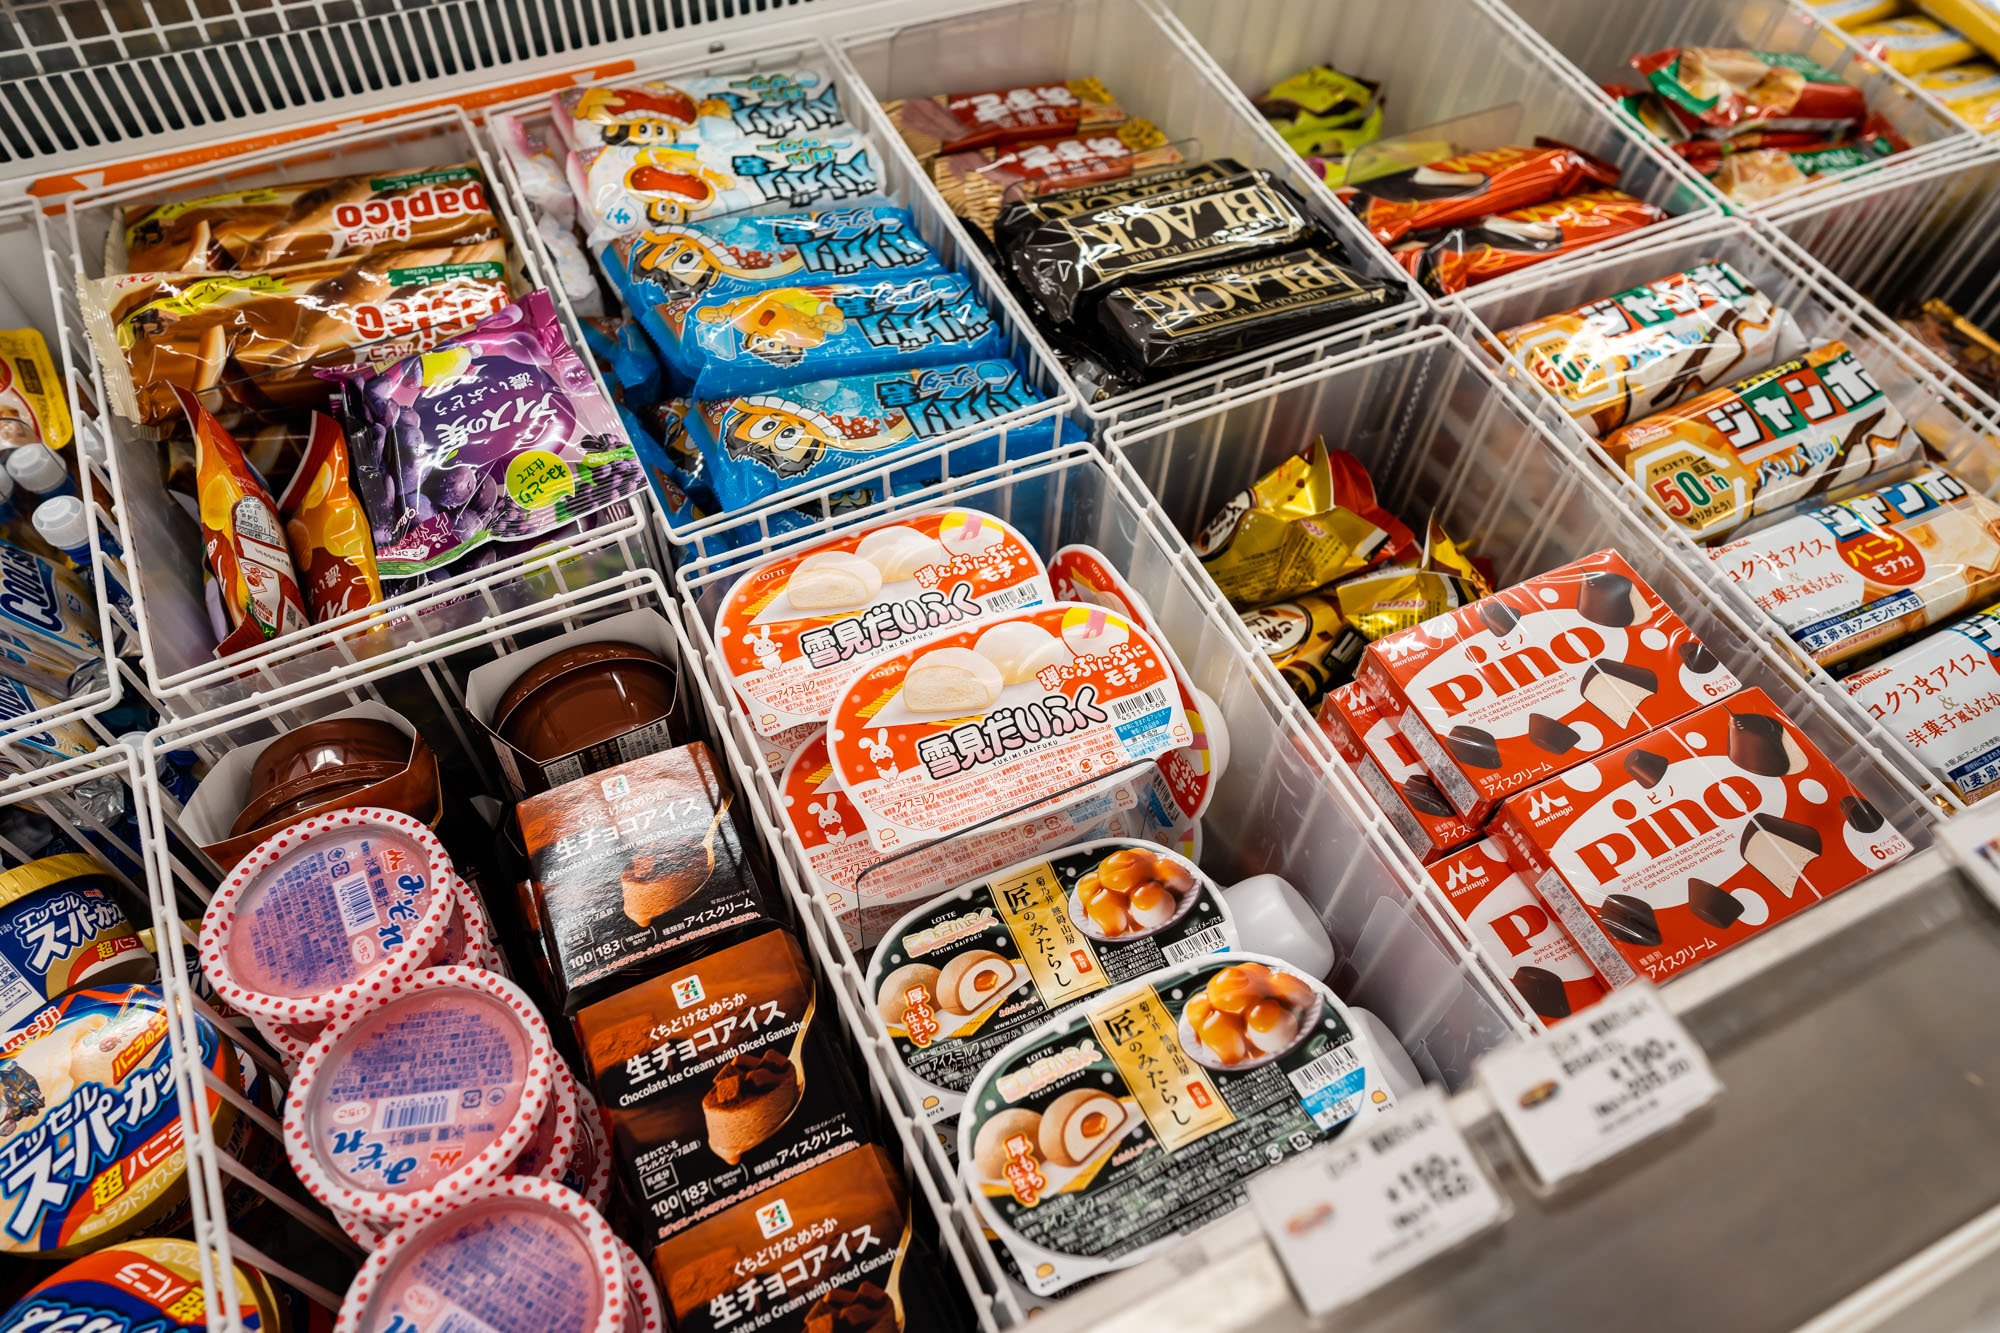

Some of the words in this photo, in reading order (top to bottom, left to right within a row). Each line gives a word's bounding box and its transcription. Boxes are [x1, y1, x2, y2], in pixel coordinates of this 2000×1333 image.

[336, 183, 491, 238] papico
[1081, 187, 1272, 259] BLACK
[1144, 261, 1340, 321] BLACK
[435, 371, 535, 418] 濃いぶどう
[1705, 355, 1884, 450] ジャンボ
[516, 457, 545, 484] 仕立て
[517, 463, 567, 505] ねっとり
[1653, 471, 1730, 518] 50th
[755, 567, 789, 583] LOTTE
[914, 543, 1021, 589] 弾むぷにぷに
[981, 560, 1016, 583] モチ
[1872, 555, 1916, 577] モナカ
[800, 583, 982, 670] 雪見だいふく
[869, 642, 901, 658] YUKIMI
[900, 630, 934, 646] DAIFUKU
[1497, 633, 1525, 653] ピノ
[1036, 643, 1148, 691] 弾むぷにぷに
[1104, 662, 1142, 688] モチ
[1391, 649, 1430, 669] morinaga
[1427, 625, 1605, 718] pino
[776, 679, 816, 700] アイスミルク
[1703, 679, 1738, 698] 6粒入り
[1867, 653, 1986, 721] コクうまアイス
[1938, 694, 1960, 711] &
[1144, 699, 1166, 713] 6568
[1468, 704, 1486, 718] SINCE
[1486, 704, 1507, 719] CREAM
[1506, 694, 1533, 712] COVERED
[1488, 713, 1500, 725] FOR
[1500, 708, 1512, 721] YOU
[1521, 697, 1540, 712] ENJOY
[917, 685, 1108, 780] 雪見だいふく
[991, 752, 1022, 767] YUKIMI
[1022, 739, 1059, 756] DAIFUKU
[1484, 762, 1554, 797] アイスクリーム
[1646, 784, 1675, 805] ピノ
[894, 792, 936, 813] アイスミルク
[1534, 803, 1575, 829] morinaga
[555, 798, 702, 862] 生チョコアイス
[1573, 774, 1766, 887] pino
[605, 841, 635, 859] Cream
[1621, 870, 1641, 884] SINCE
[1679, 836, 1714, 855] DELIGHTFUL
[1713, 829, 1727, 841] BIT
[1642, 867, 1664, 883] CREAM
[1662, 855, 1691, 874] COVERED
[1699, 832, 1736, 854] CHOCOLATE
[1868, 841, 1905, 861] 6粒入り
[1450, 875, 1490, 899] morinaga
[1643, 880, 1656, 892] FOR
[1655, 873, 1670, 886] YOU
[1678, 859, 1699, 876] ENJOY
[1698, 847, 1727, 866] ANYTIME.
[1035, 876, 1055, 904] 菊乃井
[18, 895, 80, 935] エッセル
[378, 874, 425, 951] みぞれ
[684, 898, 757, 929] アイスクリーム
[930, 910, 958, 925] LOTTE
[97, 935, 140, 961] 超バニラ
[930, 944, 955, 957] YUKIMI
[954, 932, 984, 949] DAIFUKU
[1003, 881, 1073, 988] 匠のみたらし
[1203, 940, 1226, 953] 7135
[1533, 943, 1554, 958] SINCE
[568, 951, 594, 970] 100
[596, 939, 622, 959] 183
[1644, 935, 1719, 980] アイスクリーム
[3, 1006, 62, 1053] meiji
[649, 991, 748, 1042] くちどけなめらか
[905, 1012, 928, 1046] 仕立て
[993, 1004, 1045, 1031] www.lotte.co.jp
[625, 999, 788, 1085] 生チョコアイス
[929, 1042, 981, 1070] アイスミルク
[1026, 1047, 1055, 1064] LOTTE
[619, 1078, 668, 1107] Chocolate
[668, 1069, 684, 1088] Ice
[683, 1058, 717, 1080] Cream
[716, 1047, 739, 1067] with
[738, 1036, 767, 1056] Diced
[1104, 1009, 1192, 1127] 匠のみたらし
[0, 1085, 98, 1179] エッセル
[776, 1122, 853, 1165] アイスクリーム
[332, 1130, 417, 1185] みぞれ
[650, 1194, 680, 1219] 100
[680, 1180, 711, 1205] 183
[733, 1216, 839, 1278] くちどけなめらか
[708, 1223, 882, 1331] 生チョコアイス
[758, 1310, 773, 1324] Ice
[771, 1296, 808, 1318] Cream
[805, 1284, 831, 1303] with
[829, 1268, 861, 1289] Diced
